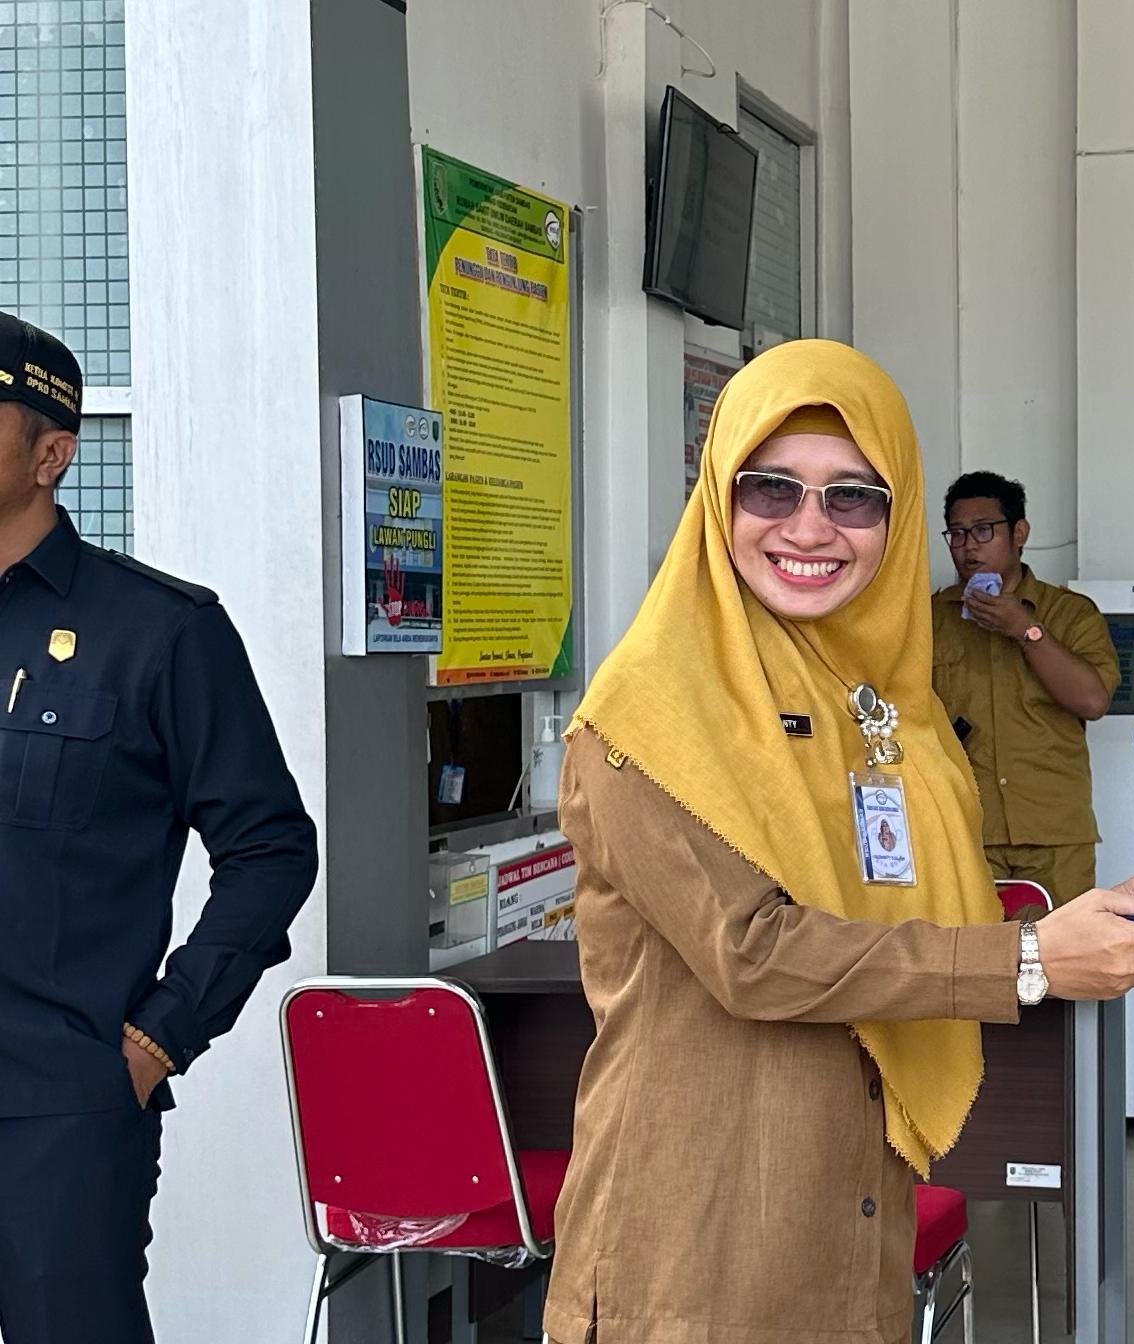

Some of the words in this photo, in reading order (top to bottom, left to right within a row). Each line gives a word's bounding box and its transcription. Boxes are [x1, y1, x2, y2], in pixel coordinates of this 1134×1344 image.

[367, 439, 396, 475] RSUD
[399, 444, 441, 481] SAMBAS
[388, 486, 421, 519] SIAP
[373, 525, 404, 548] LAWAN
[405, 528, 437, 551] PUNGLI
